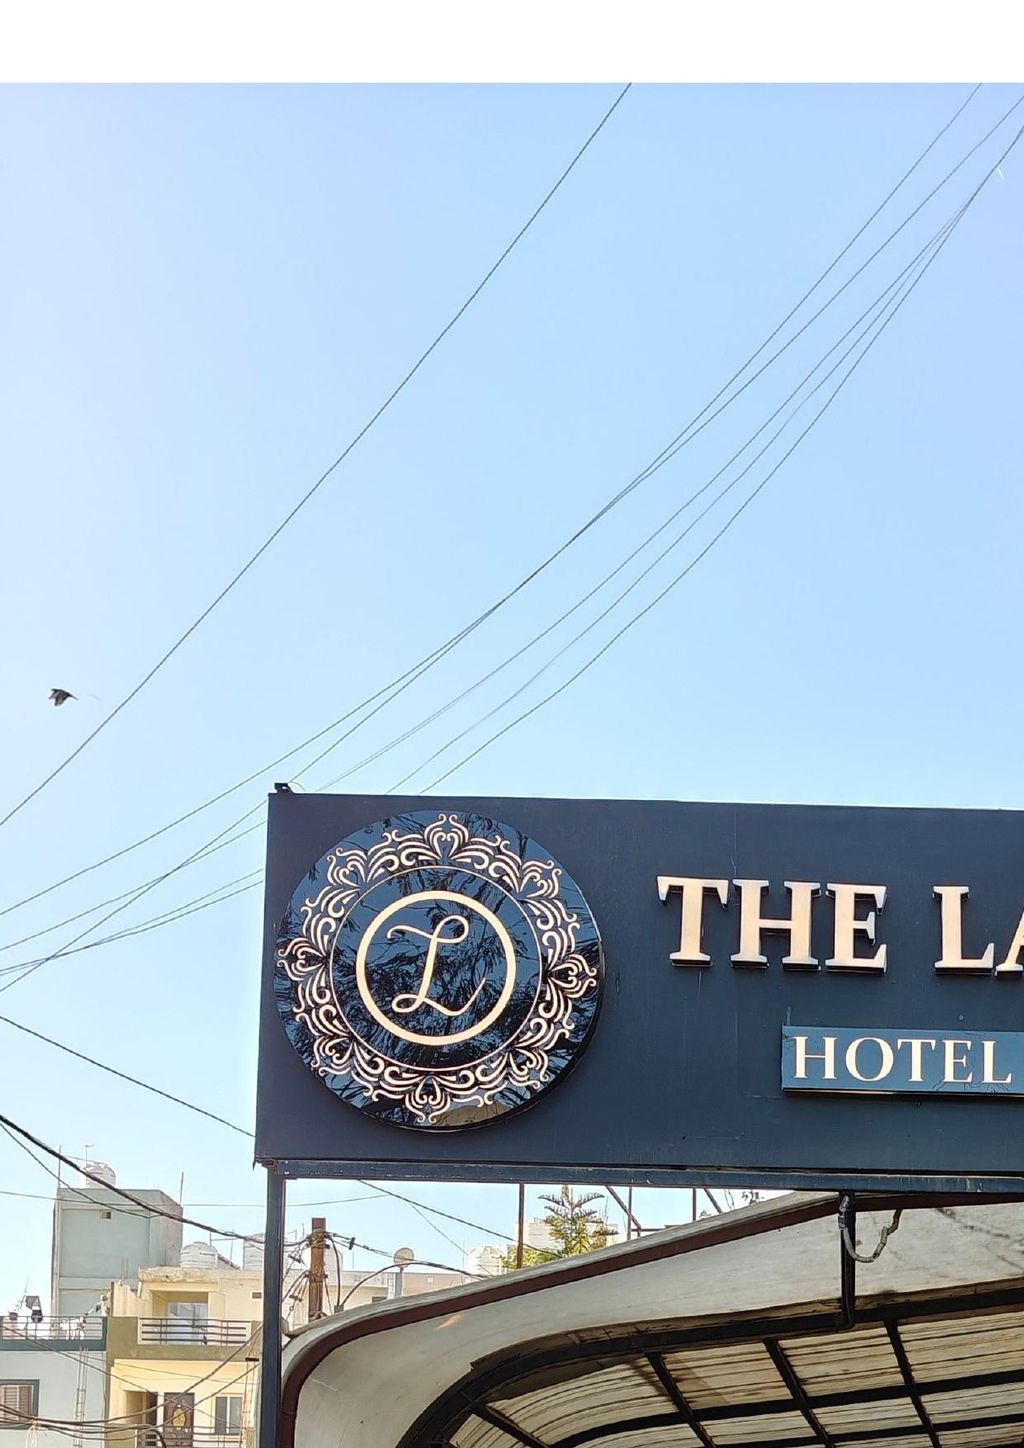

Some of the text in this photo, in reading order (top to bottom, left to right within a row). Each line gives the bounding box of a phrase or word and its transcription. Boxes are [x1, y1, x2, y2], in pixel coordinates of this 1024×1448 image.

[386, 915, 486, 1015] L
[657, 876, 887, 972] THE
[792, 1036, 1014, 1086] HOTEL
